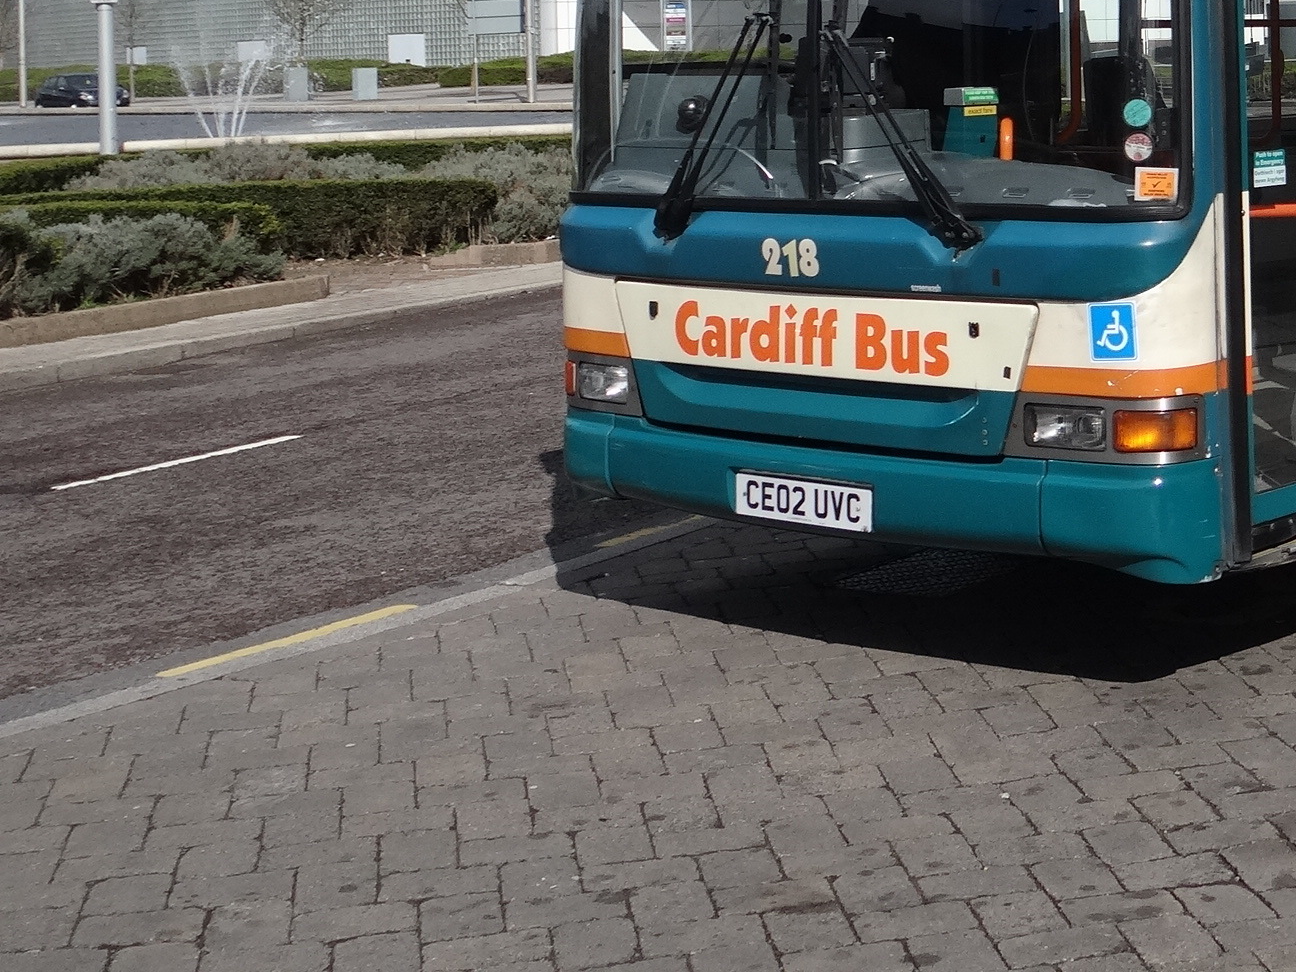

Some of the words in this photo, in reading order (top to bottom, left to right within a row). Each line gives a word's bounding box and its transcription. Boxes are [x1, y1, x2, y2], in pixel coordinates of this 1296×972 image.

[761, 237, 820, 277] 218
[674, 300, 838, 367] Cardiff
[855, 312, 950, 377] Bus
[746, 480, 806, 517] CE02
[814, 488, 861, 523] UVC
